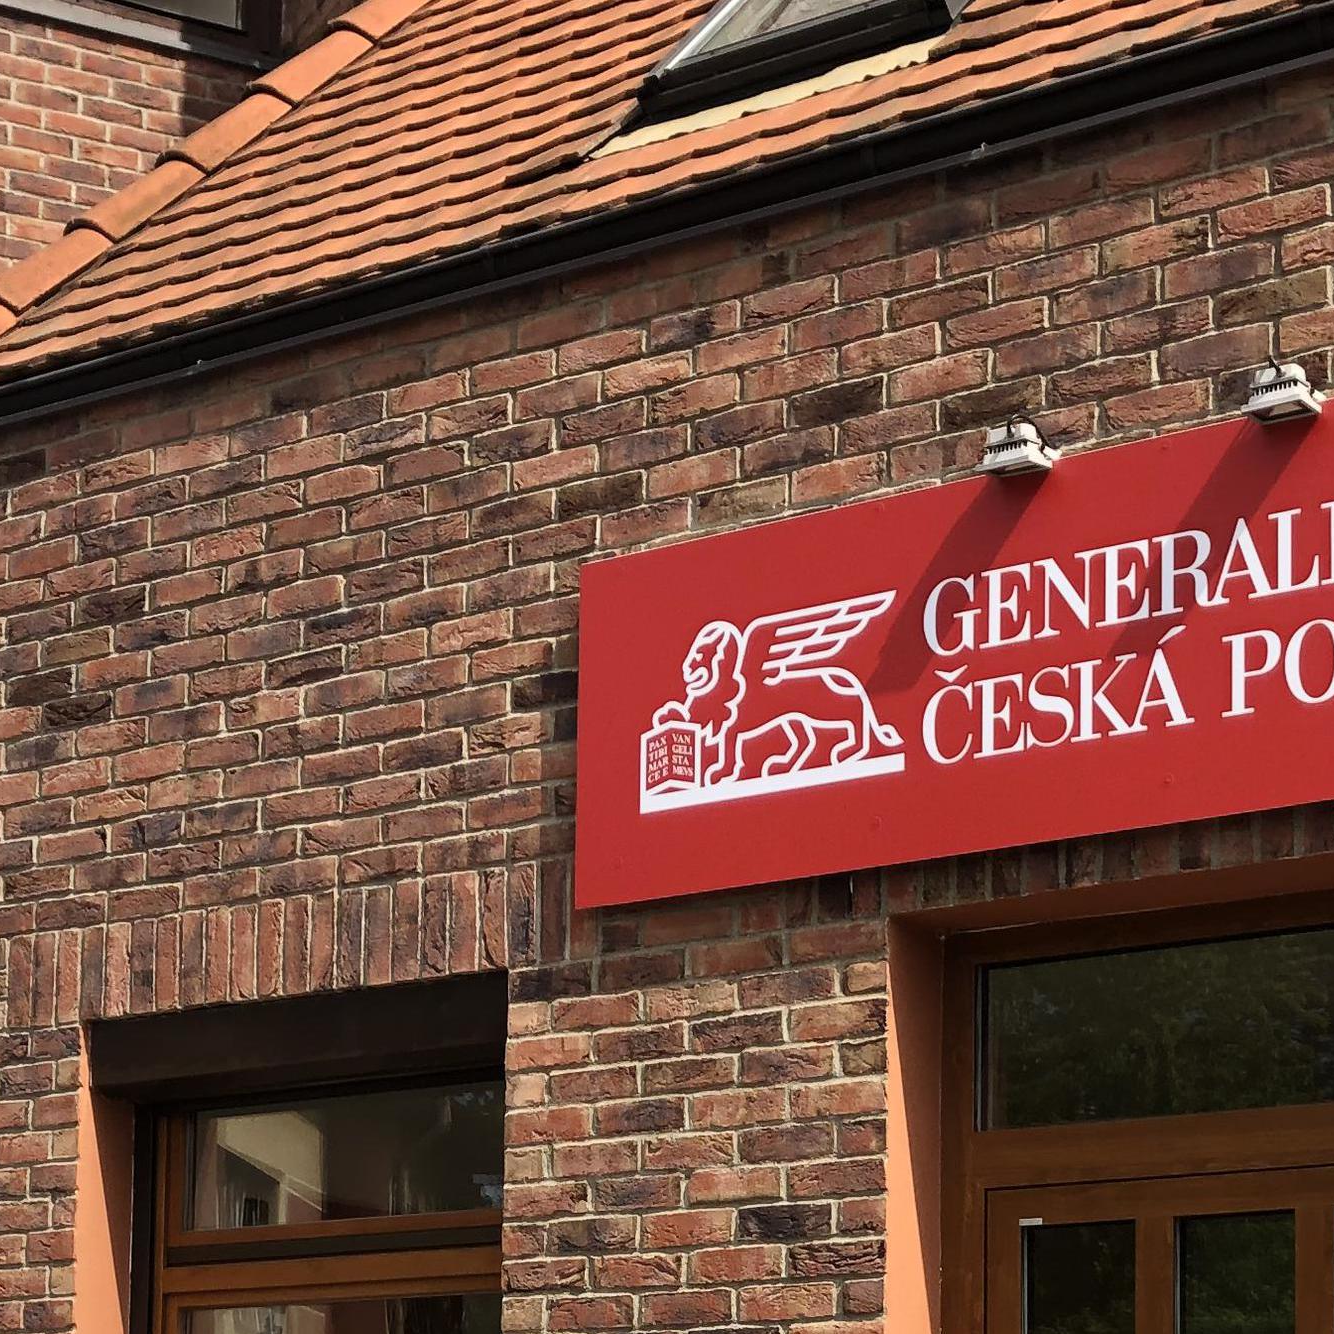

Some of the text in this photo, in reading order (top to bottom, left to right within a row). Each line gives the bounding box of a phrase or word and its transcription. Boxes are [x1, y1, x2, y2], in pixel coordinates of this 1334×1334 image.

[921, 625, 1197, 765] ČESKÁ
[648, 735, 667, 752] PAX
[671, 733, 691, 744] VAN
[648, 745, 668, 762] TIBI
[671, 744, 693, 756] GELI
[648, 756, 669, 773] MAR
[671, 755, 690, 766] STA
[647, 770, 661, 783] CE
